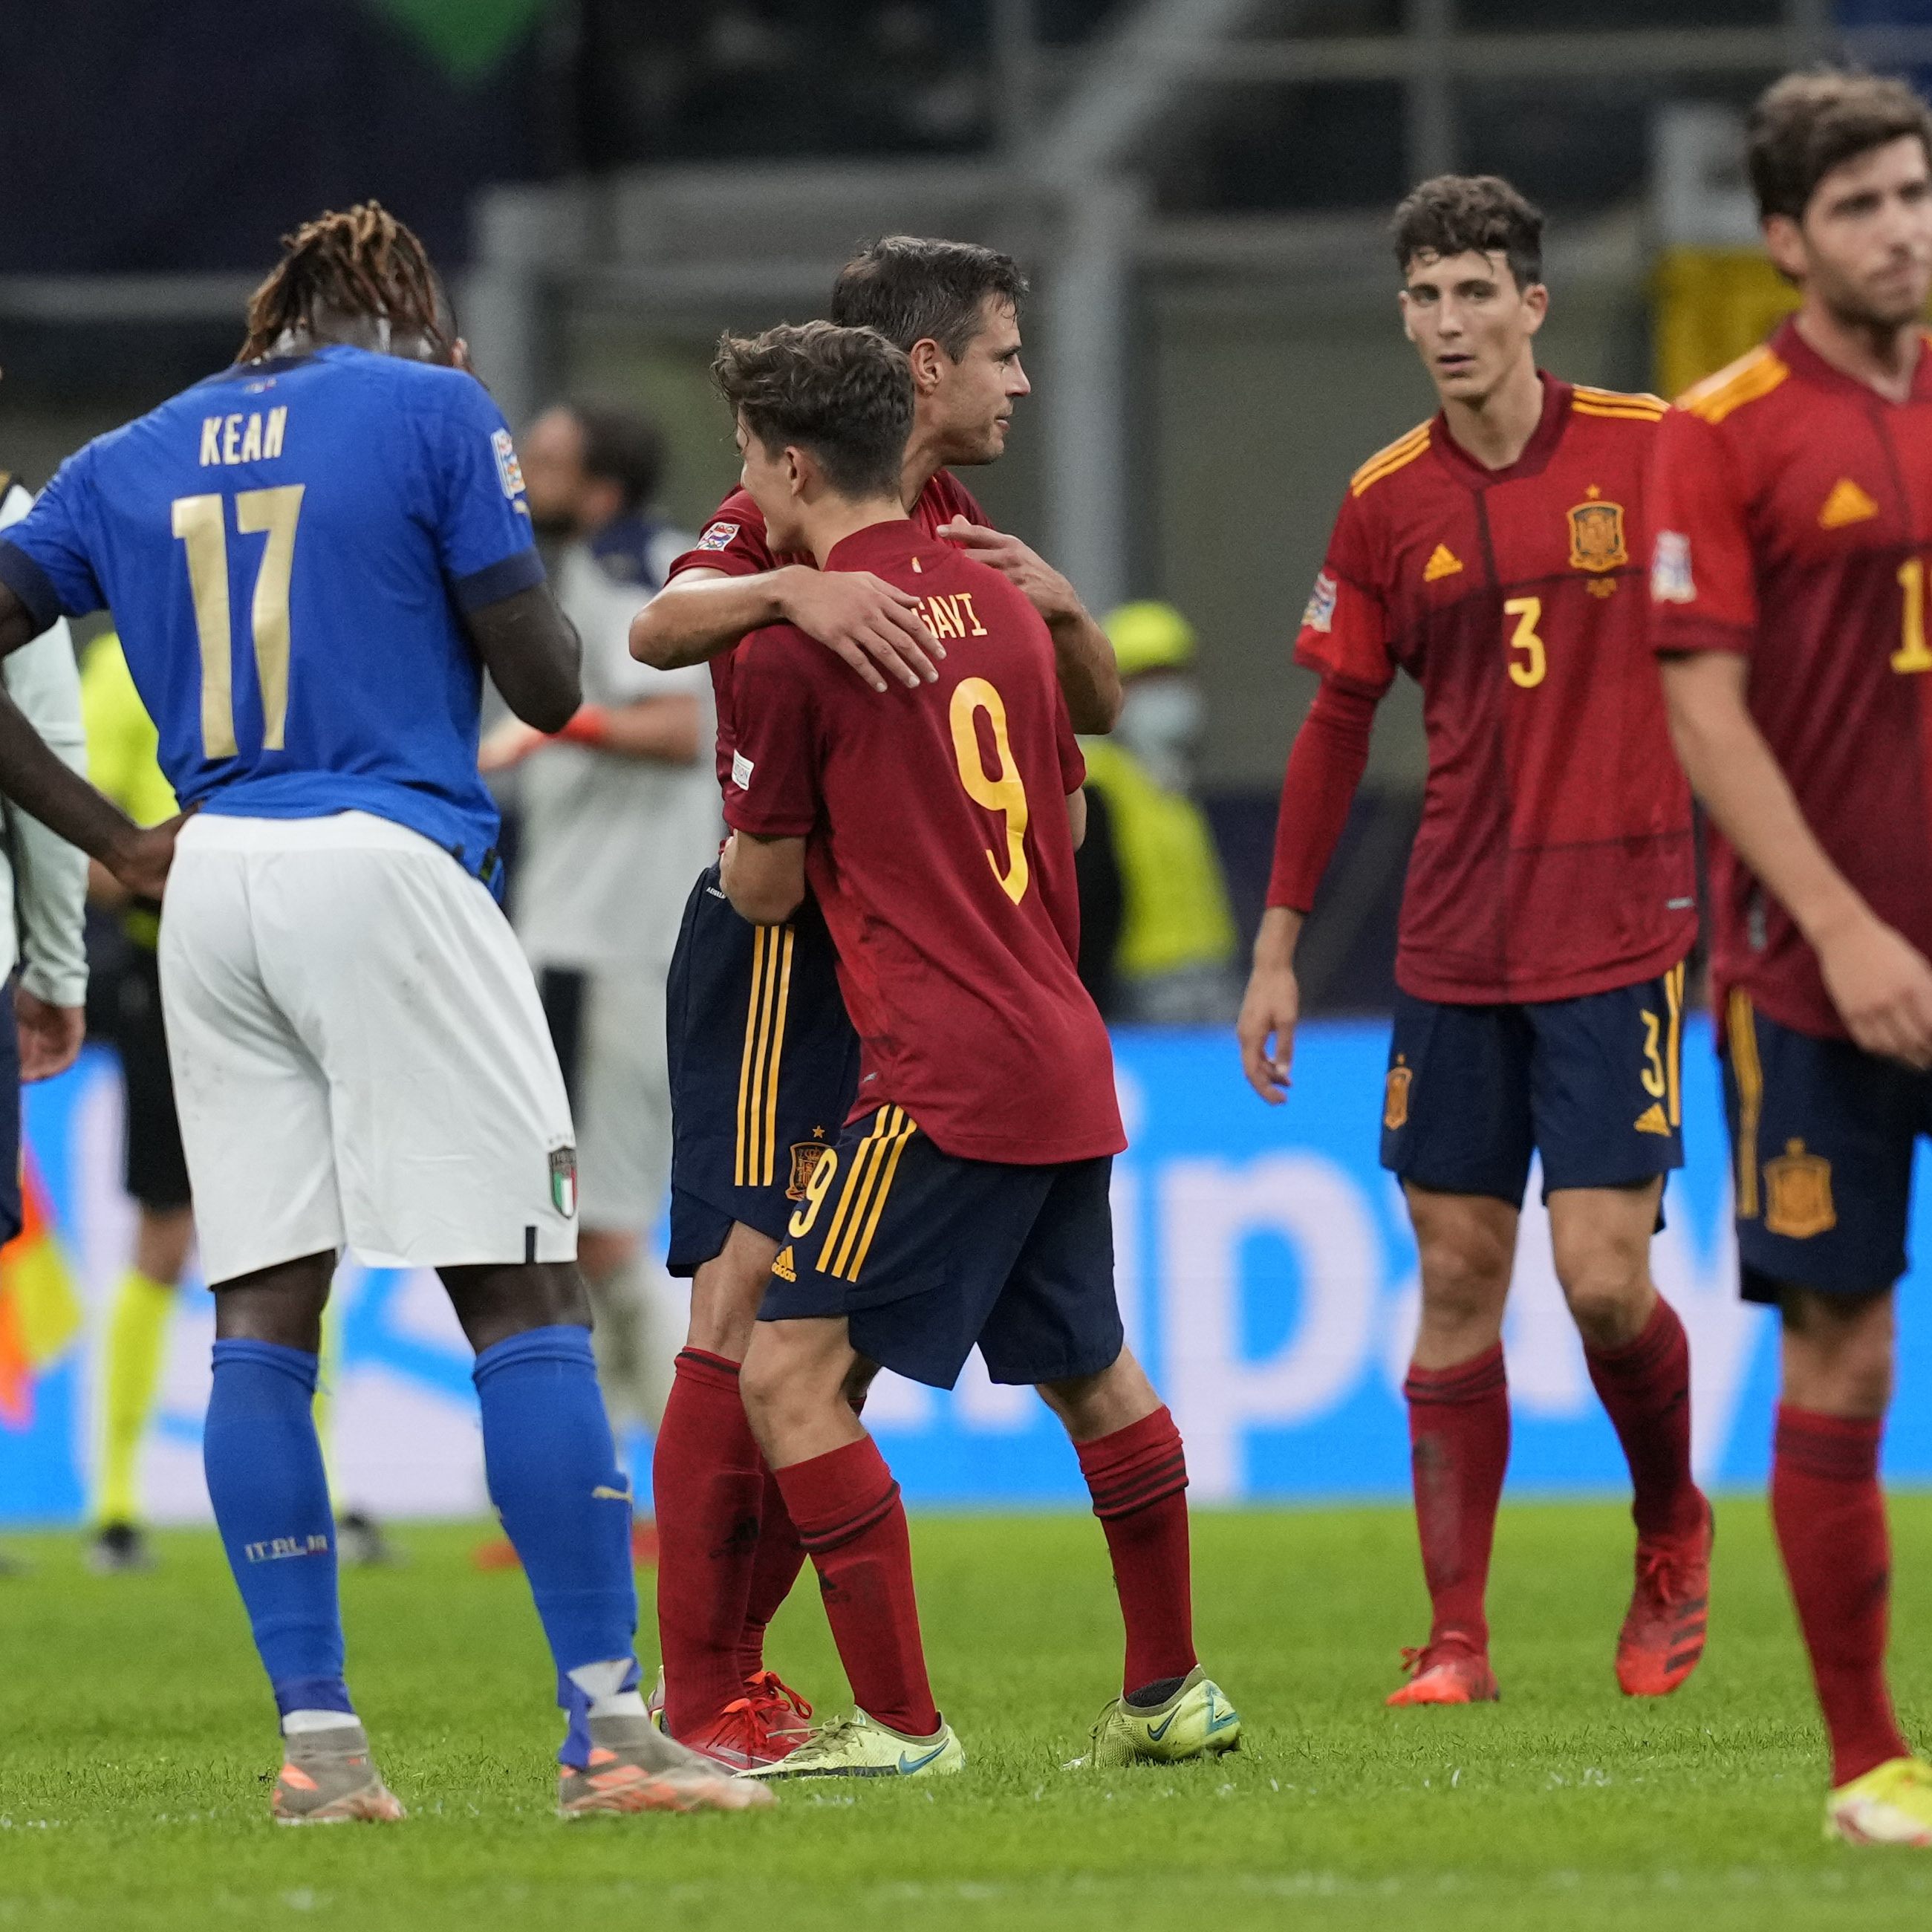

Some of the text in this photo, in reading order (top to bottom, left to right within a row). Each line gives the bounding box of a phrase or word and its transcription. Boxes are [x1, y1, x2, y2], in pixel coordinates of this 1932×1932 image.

[199, 405, 288, 467] KEAN
[171, 484, 306, 760] 17
[911, 593, 988, 639] GAVI
[1503, 596, 1546, 689] 3
[1891, 559, 1932, 674] 1
[949, 677, 1029, 906] 9
[1640, 1009, 1665, 1098] 3
[788, 1148, 838, 1239] 9
